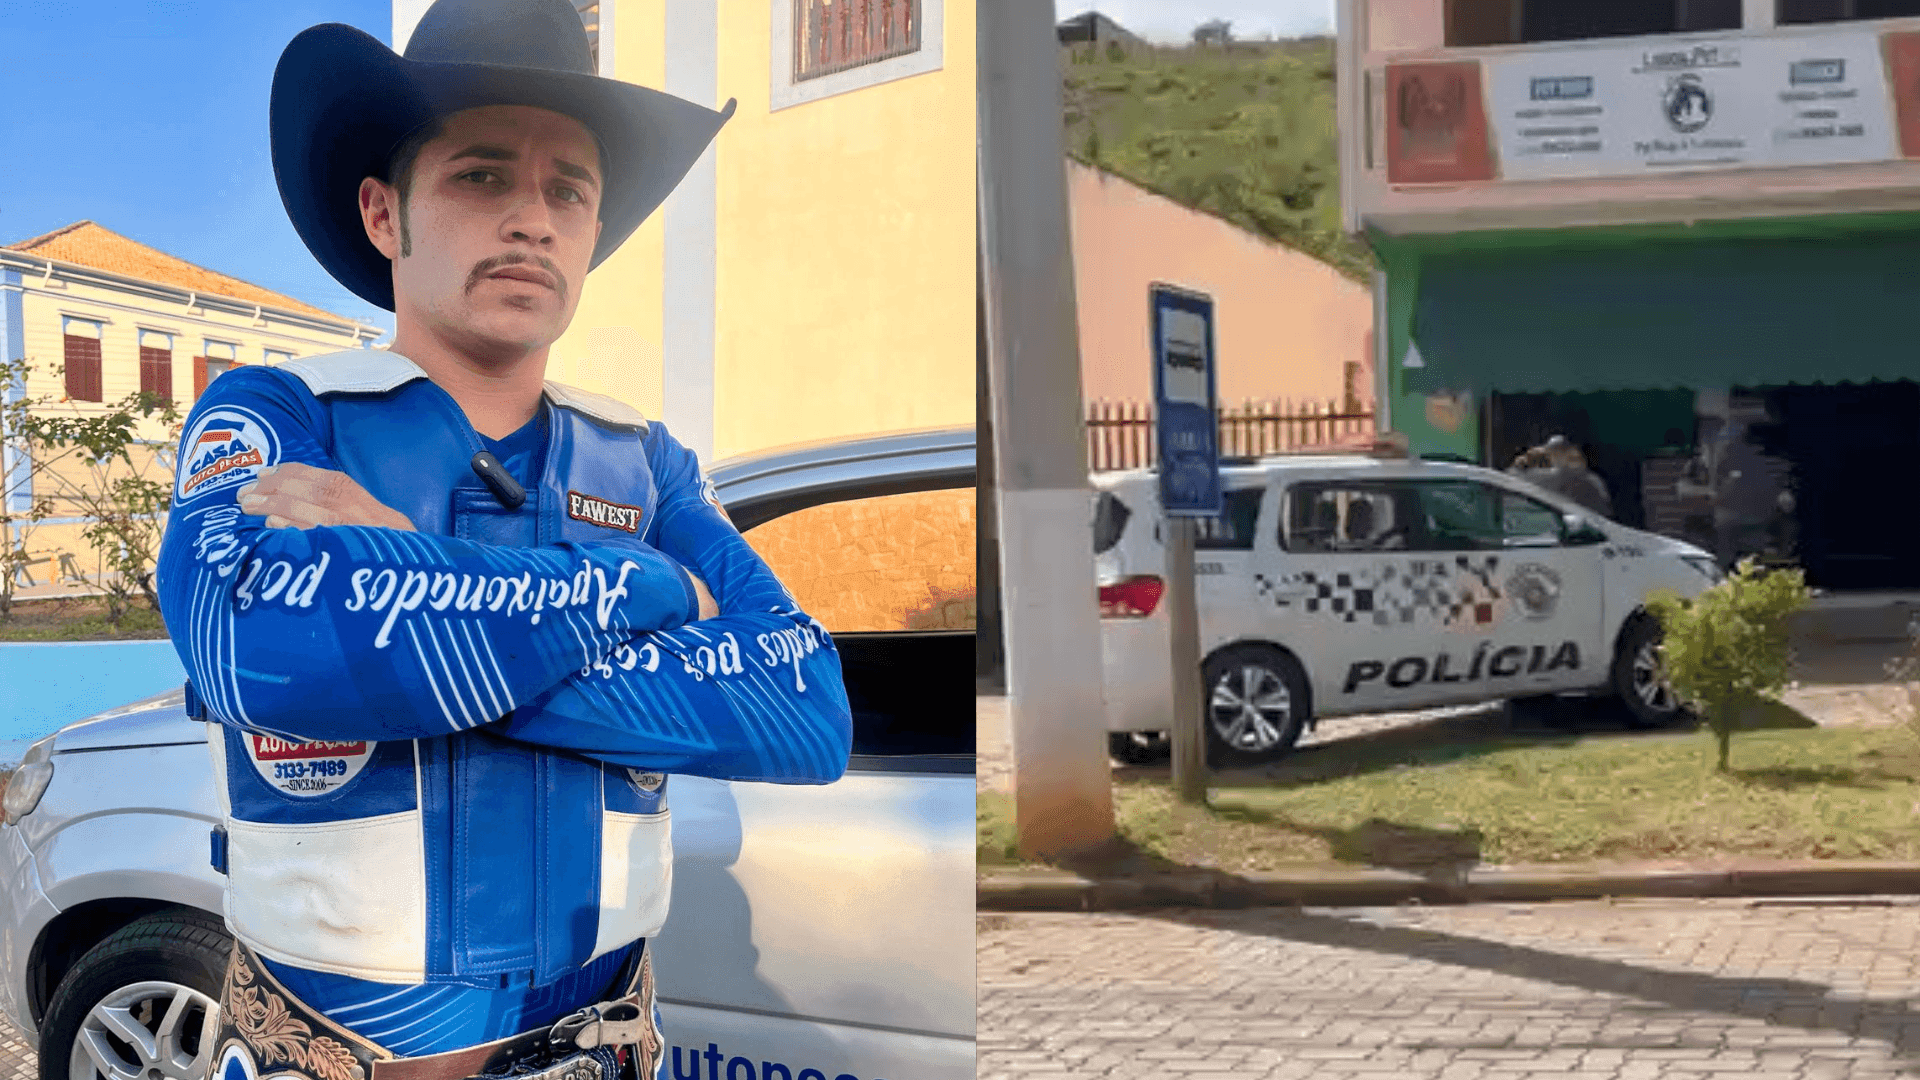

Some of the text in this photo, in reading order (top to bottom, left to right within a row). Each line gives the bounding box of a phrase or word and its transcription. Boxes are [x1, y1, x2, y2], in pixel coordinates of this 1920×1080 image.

[190, 438, 249, 476] CASA
[187, 467, 216, 489] AUTO
[194, 468, 251, 493] 3133-7489
[571, 494, 640, 530] FAWEST
[236, 550, 331, 610] por
[345, 558, 641, 649] Apaixonados
[1342, 639, 1582, 694] POLÍCIA
[274, 759, 348, 779] 3133-7489
[289, 778, 310, 791] SINCE
